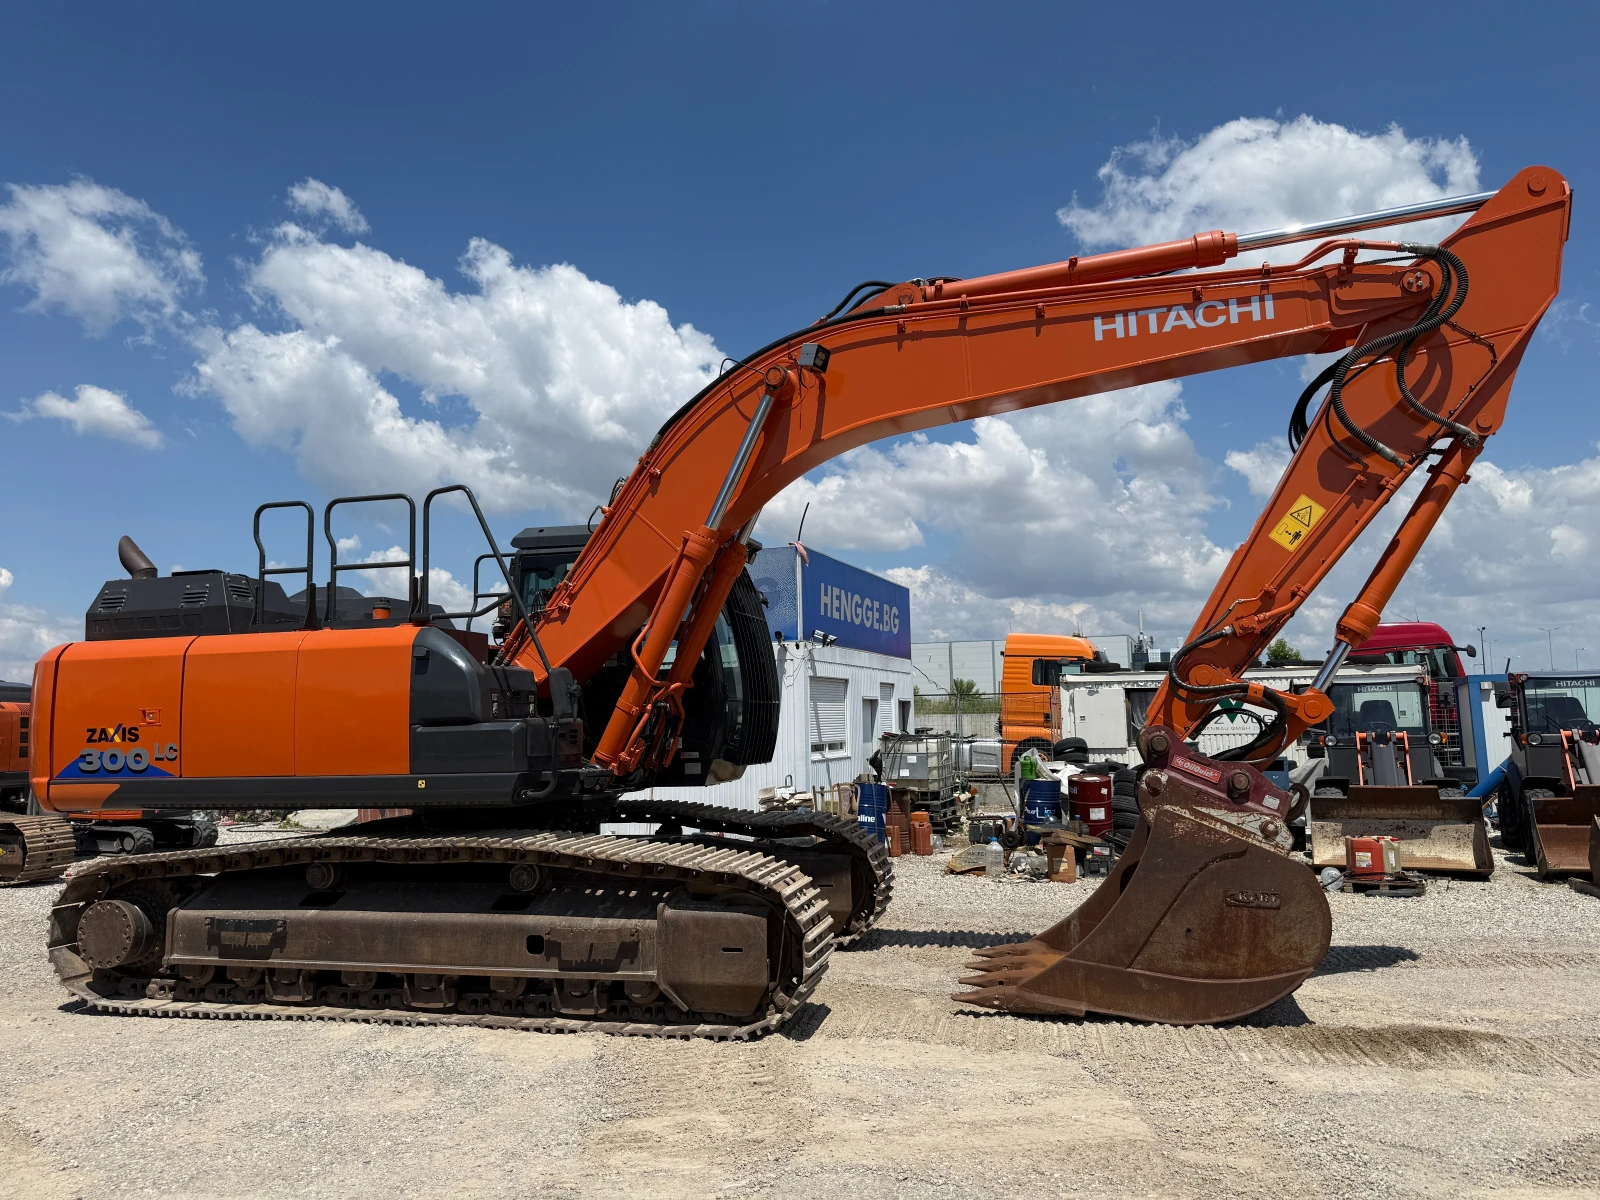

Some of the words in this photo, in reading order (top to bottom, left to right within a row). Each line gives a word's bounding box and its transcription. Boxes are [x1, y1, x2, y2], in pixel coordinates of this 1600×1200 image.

[1093, 294, 1275, 341] HITACHI
[820, 582, 899, 635] HENGGE.BG
[1357, 685, 1393, 693] HITACHI
[86, 723, 140, 743] ZAXIS
[78, 747, 151, 774] 300
[153, 742, 178, 761] LC
[1183, 762, 1216, 778] OilQuick
